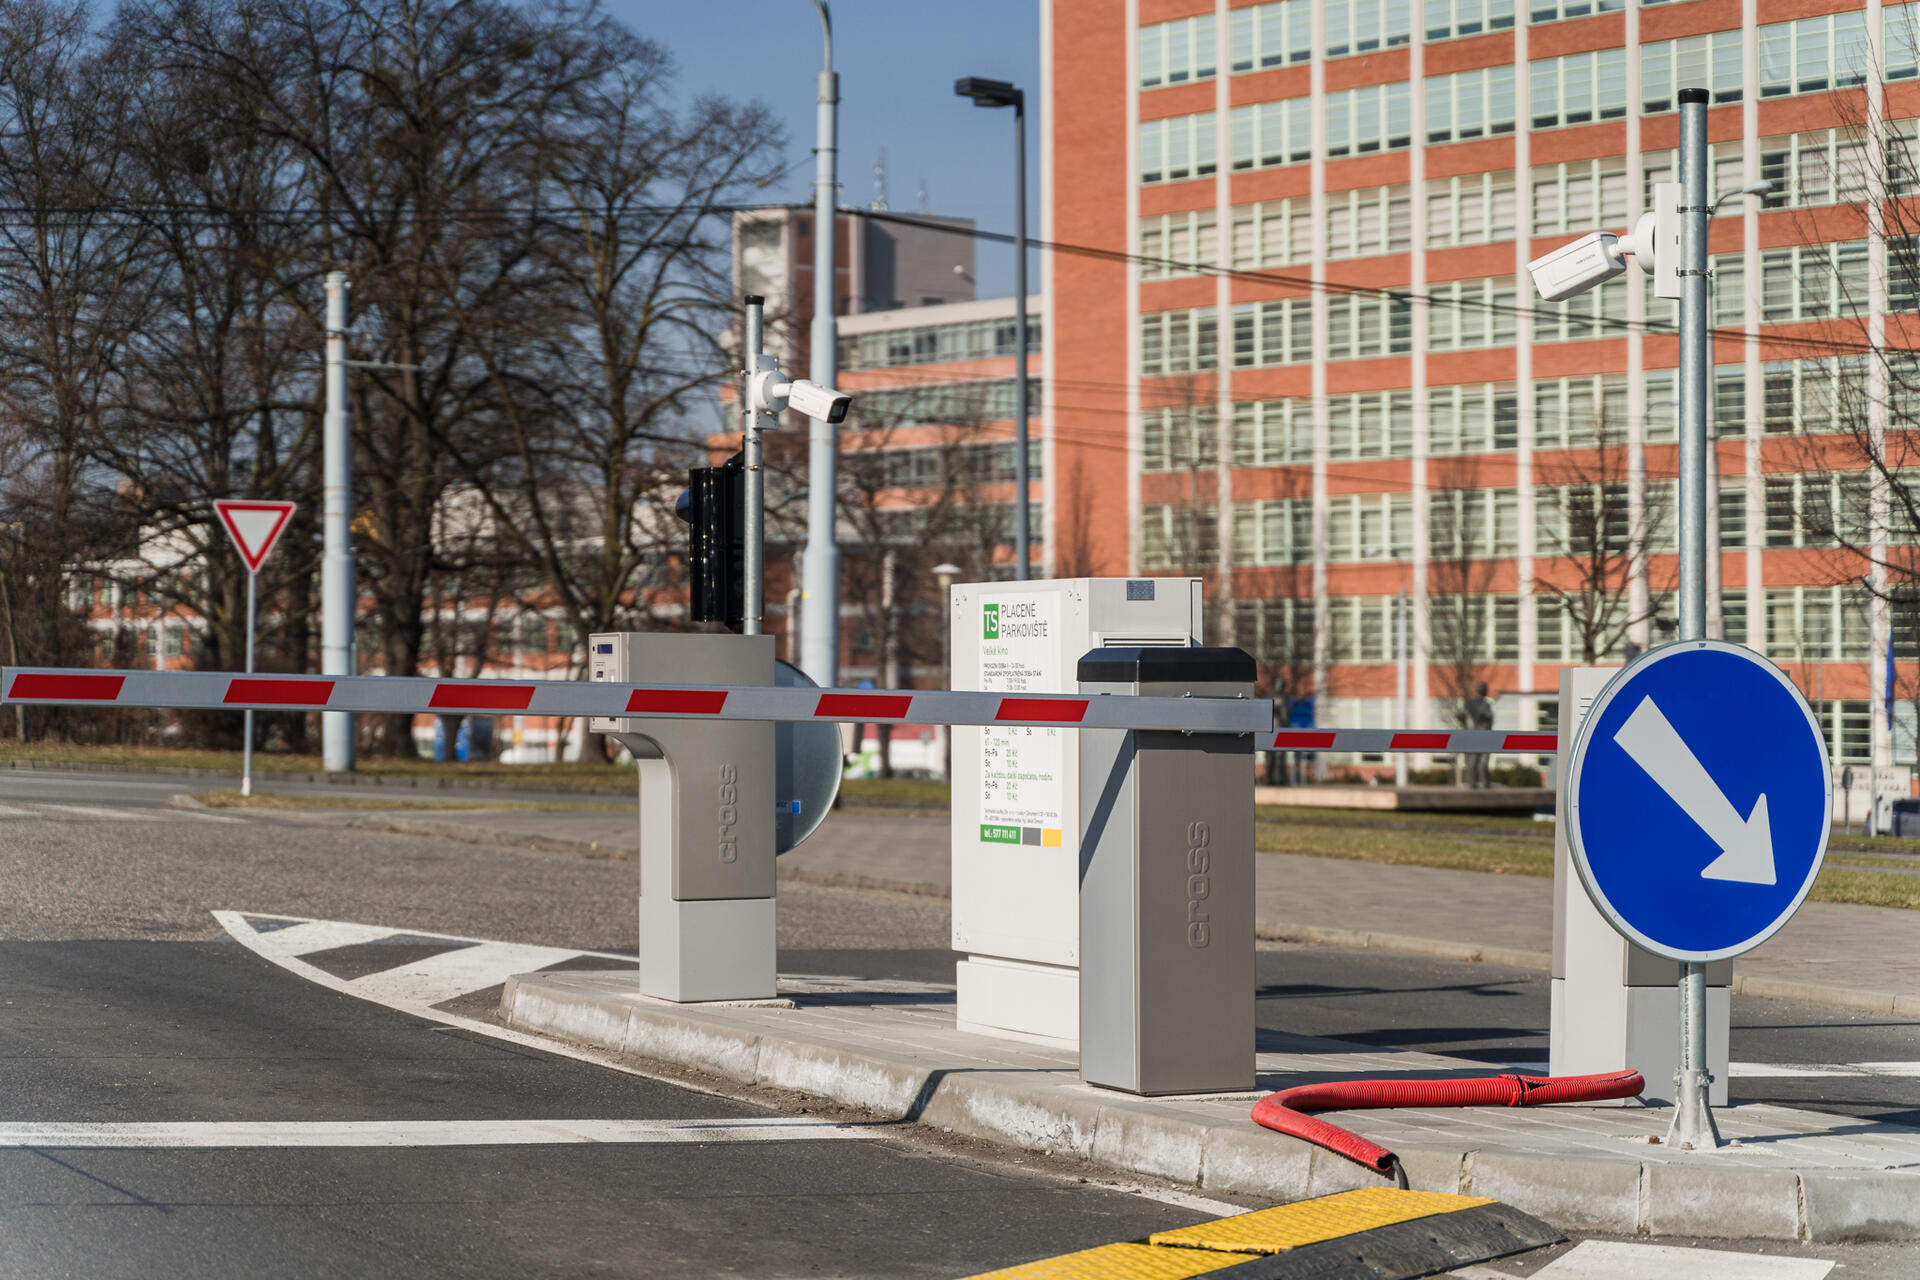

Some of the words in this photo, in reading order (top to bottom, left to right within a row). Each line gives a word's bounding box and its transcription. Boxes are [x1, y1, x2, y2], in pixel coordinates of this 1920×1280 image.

[1001, 600, 1036, 618] PLACENÉ
[984, 610, 998, 632] TS
[1001, 620, 1048, 638] PARKOVIŠTĚ
[998, 646, 1009, 656] kino
[1027, 728, 1032, 736] So
[985, 792, 990, 800] So
[994, 828, 1002, 839] 577
